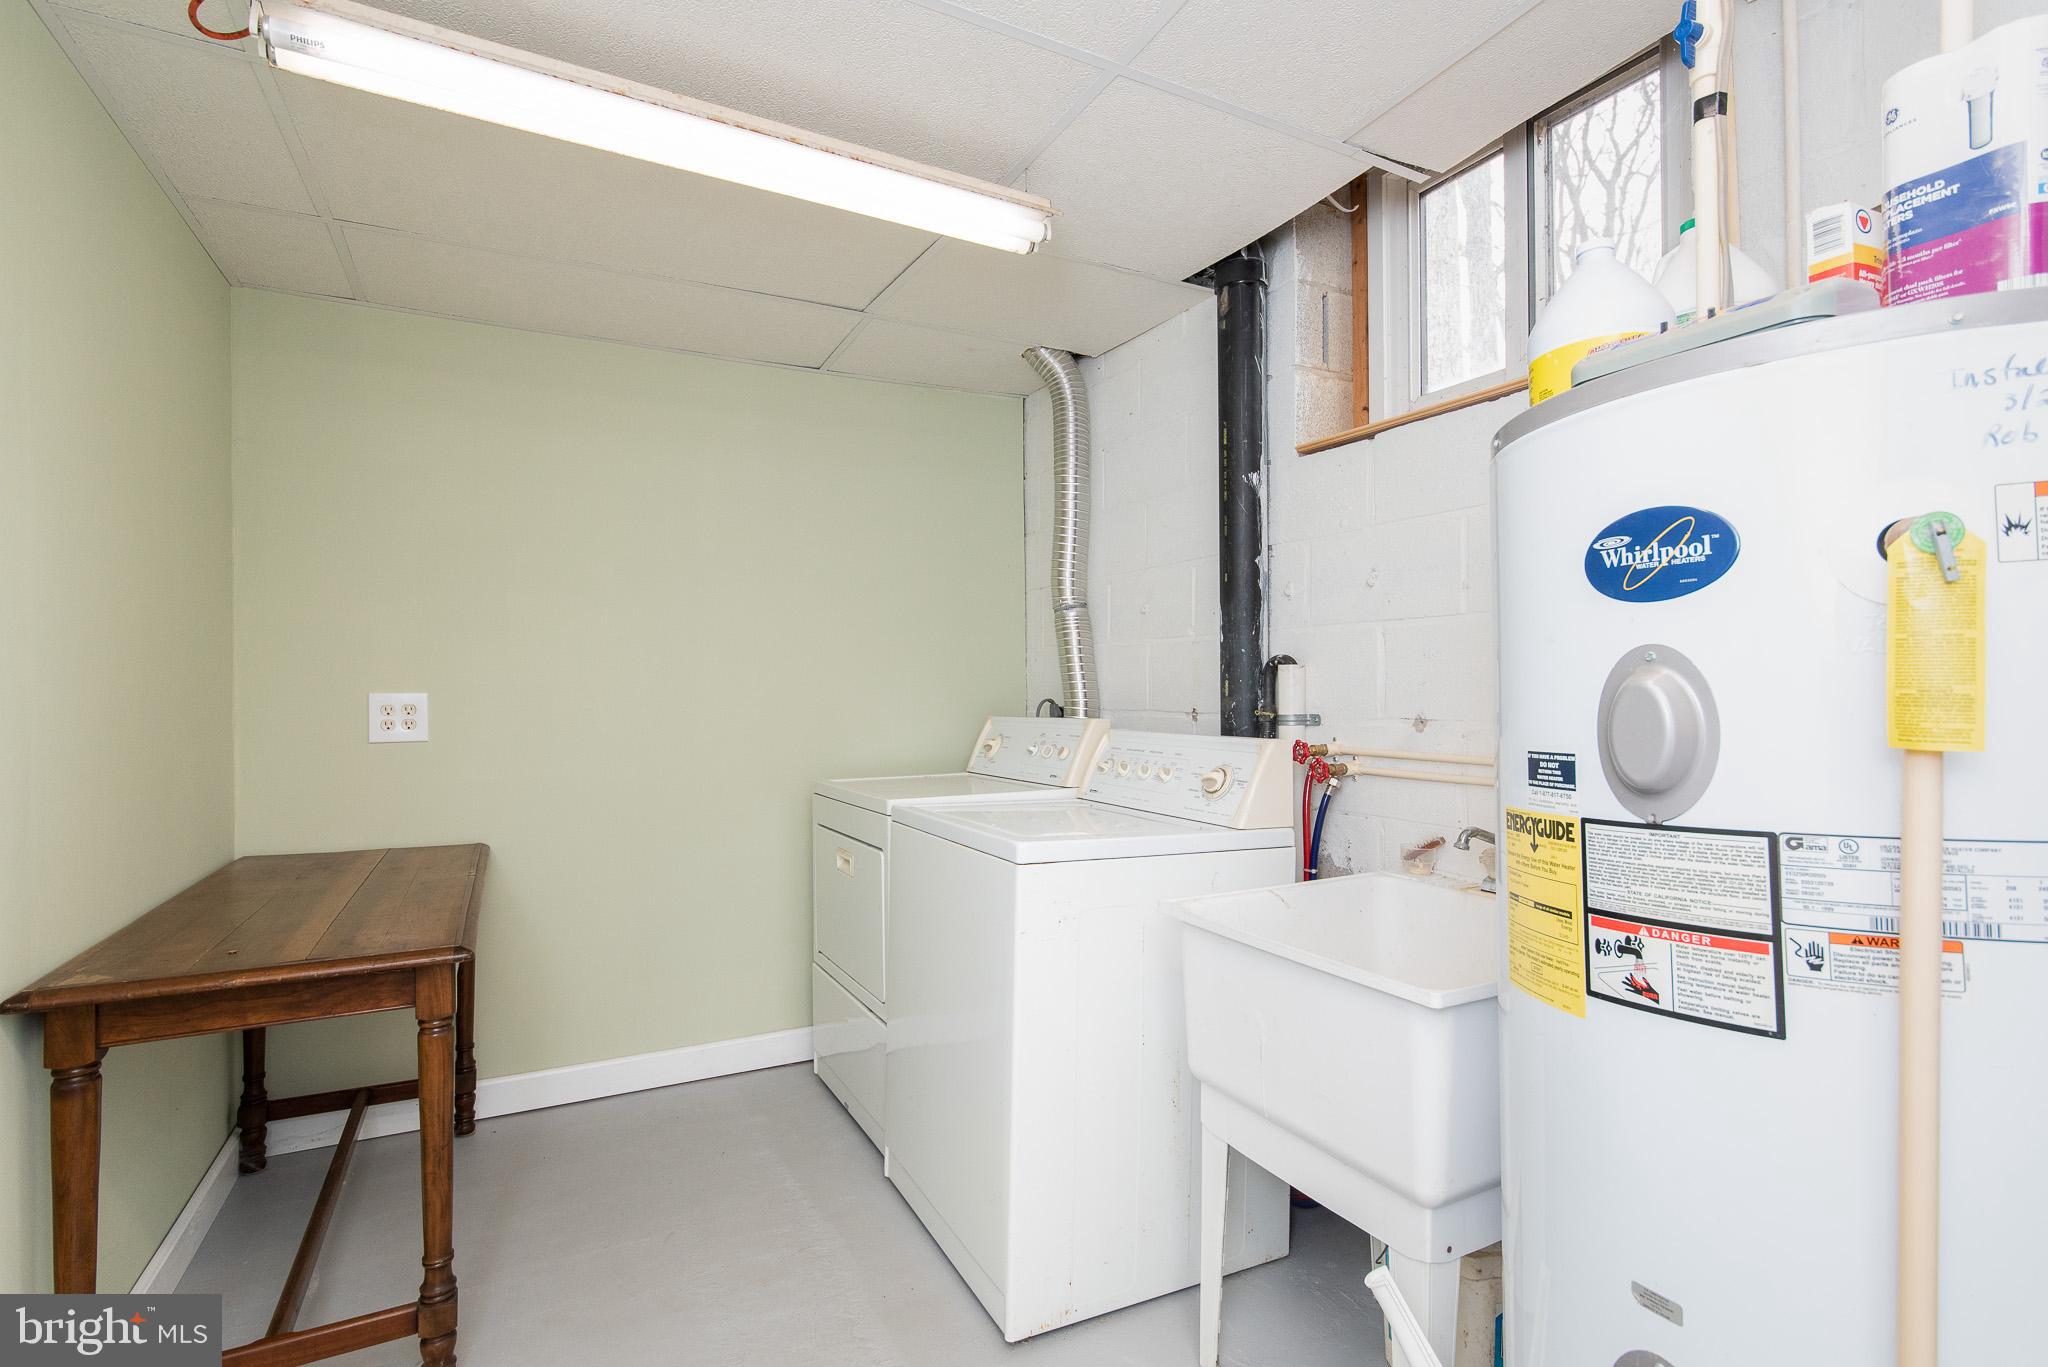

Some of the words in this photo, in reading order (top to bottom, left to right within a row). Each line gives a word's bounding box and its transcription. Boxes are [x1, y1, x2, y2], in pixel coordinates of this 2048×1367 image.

[290, 34, 325, 48] PHILIPS
[1600, 535, 1713, 569] Whirlpool
[1636, 561, 1660, 570] WATER
[1671, 555, 1706, 565] HEATERS
[1506, 811, 1575, 843] ENERGYGUIDE
[1652, 928, 1711, 946] DANGER
[1867, 938, 1900, 953] WAR
